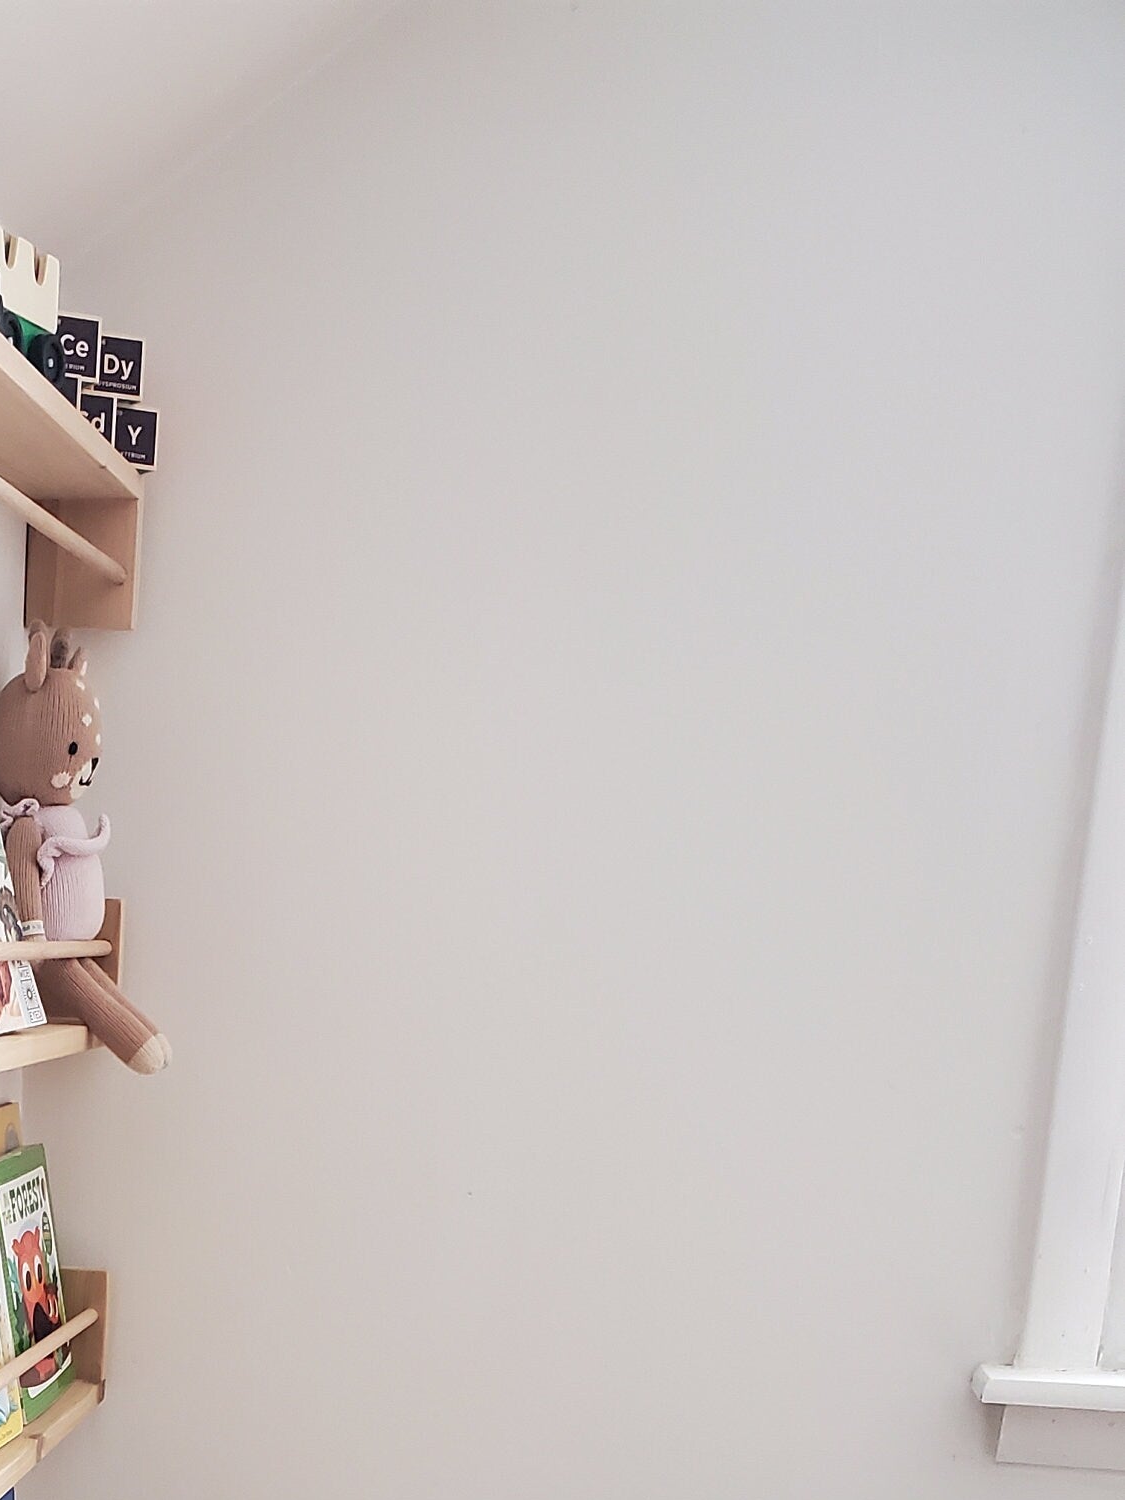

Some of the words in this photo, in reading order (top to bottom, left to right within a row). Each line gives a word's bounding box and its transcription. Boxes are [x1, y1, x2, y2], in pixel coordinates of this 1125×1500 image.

[60, 334, 89, 358] Ce
[103, 354, 134, 381] Dy
[127, 425, 143, 446] Y
[9, 1176, 41, 1223] FOREST
